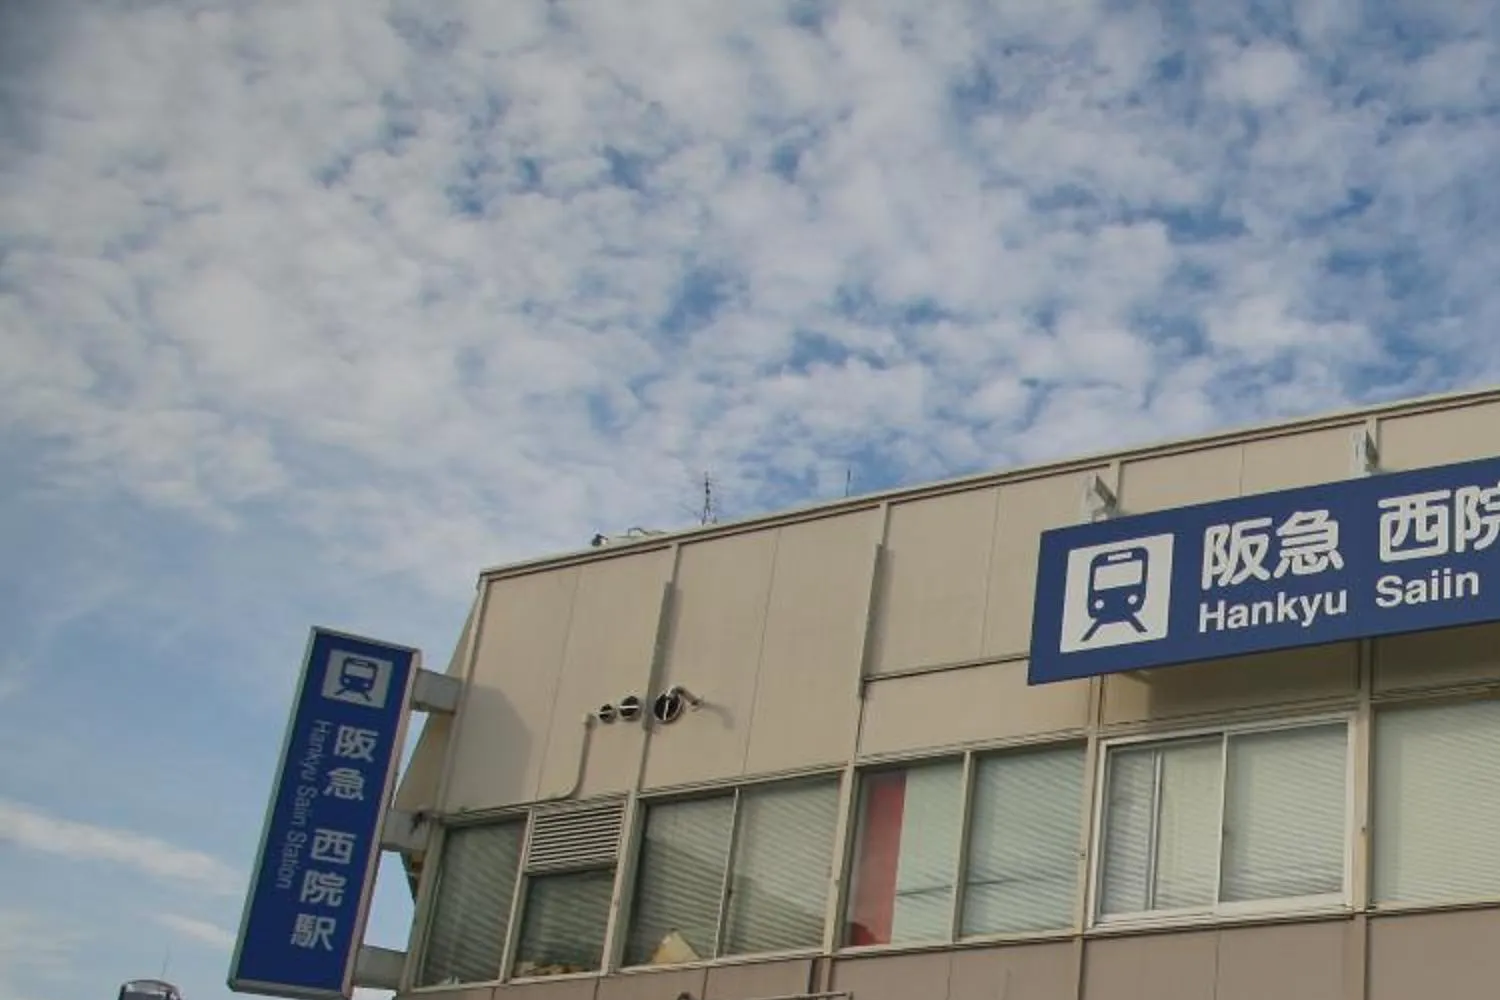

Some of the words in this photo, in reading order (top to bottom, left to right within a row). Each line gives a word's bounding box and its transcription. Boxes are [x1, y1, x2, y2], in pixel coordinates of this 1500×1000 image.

[1201, 508, 1344, 589] 阪急
[1199, 585, 1347, 633] Hankyu
[1375, 568, 1479, 609] Saiin
[322, 724, 379, 801] 阪急
[289, 827, 357, 951] 西院駅
